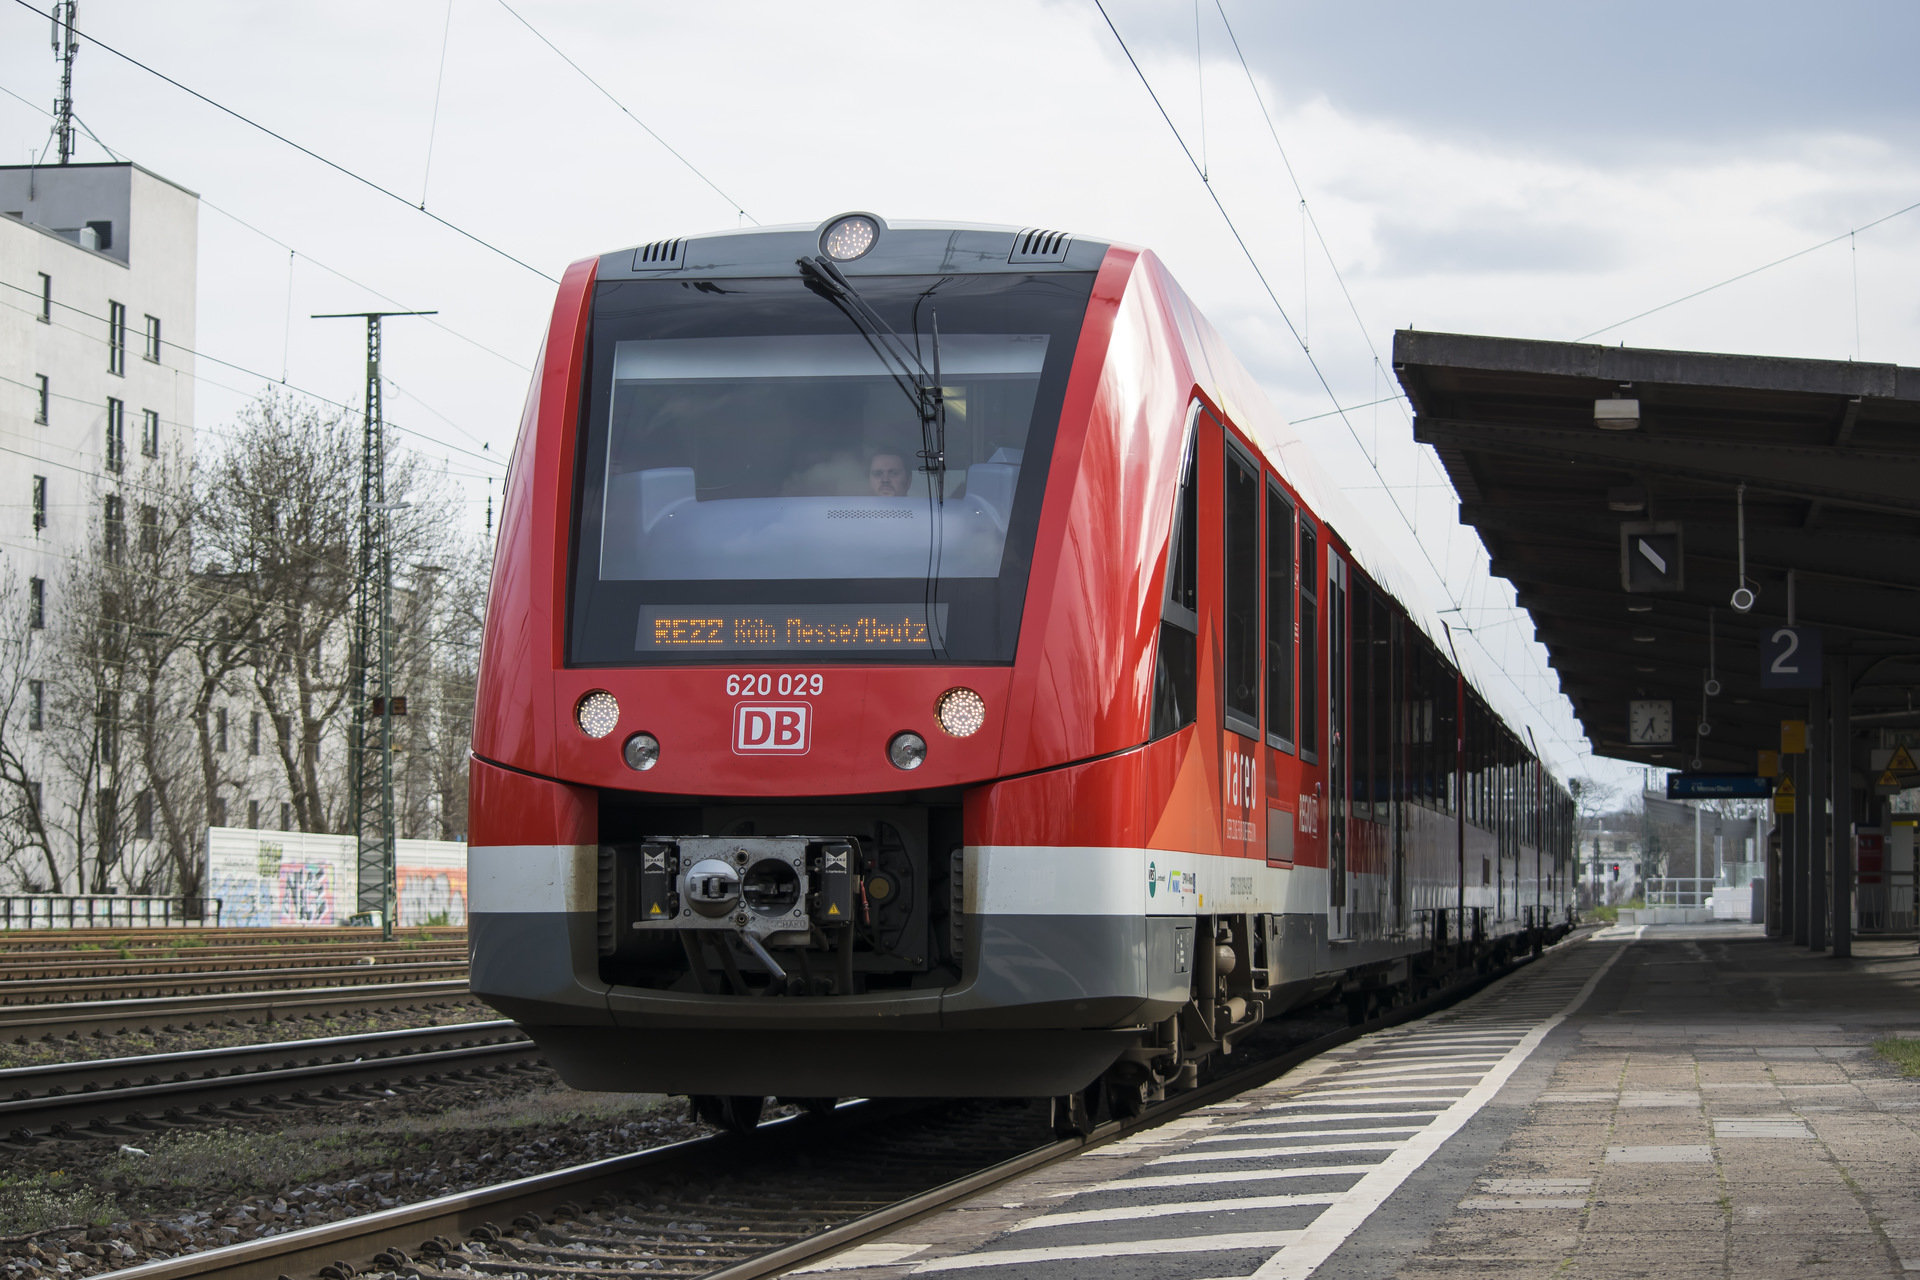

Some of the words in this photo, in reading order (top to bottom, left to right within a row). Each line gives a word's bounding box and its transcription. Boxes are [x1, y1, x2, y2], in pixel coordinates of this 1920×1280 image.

[654, 618, 724, 644] RE22
[734, 618, 776, 644] Köln
[1771, 629, 1799, 674] 2
[726, 674, 772, 696] 620
[778, 673, 824, 696] 029
[743, 710, 801, 746] DB
[1225, 749, 1257, 810] vareo
